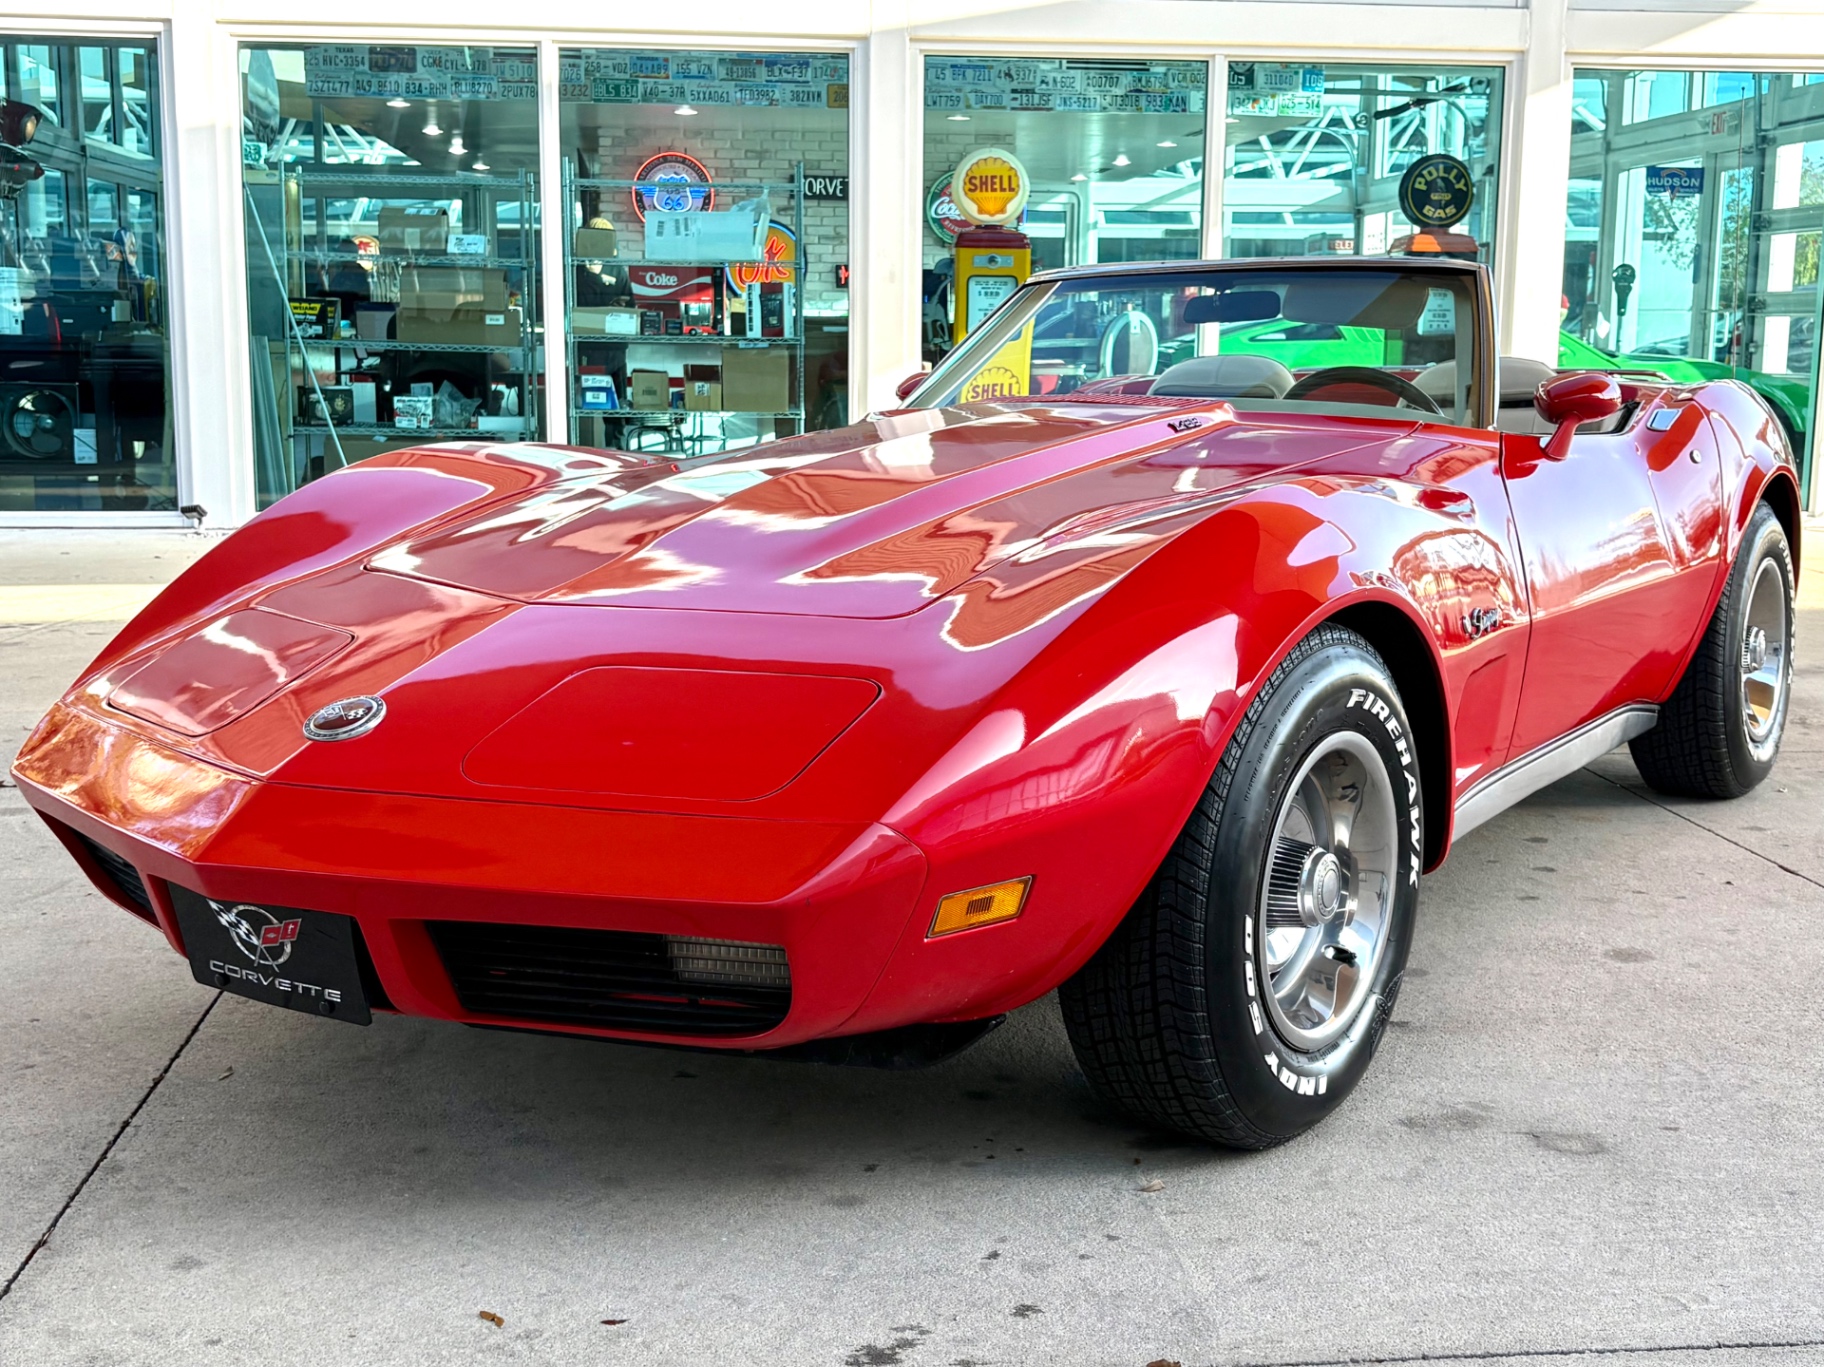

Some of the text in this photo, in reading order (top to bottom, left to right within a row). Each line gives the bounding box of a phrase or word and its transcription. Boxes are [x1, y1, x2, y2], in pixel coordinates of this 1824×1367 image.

[968, 175, 1016, 193] SHELL
[1414, 164, 1468, 191] POLLY
[1647, 177, 1700, 187] HUDSON
[805, 177, 849, 197] ORVE
[662, 195, 685, 210] 66
[1422, 204, 1458, 219] GAS
[645, 271, 678, 287] Coke
[970, 382, 1015, 400] SHELL
[1346, 688, 1421, 889] FIREHAWK
[209, 959, 341, 1003] CORVETTE
[1264, 1051, 1328, 1096] INDY
